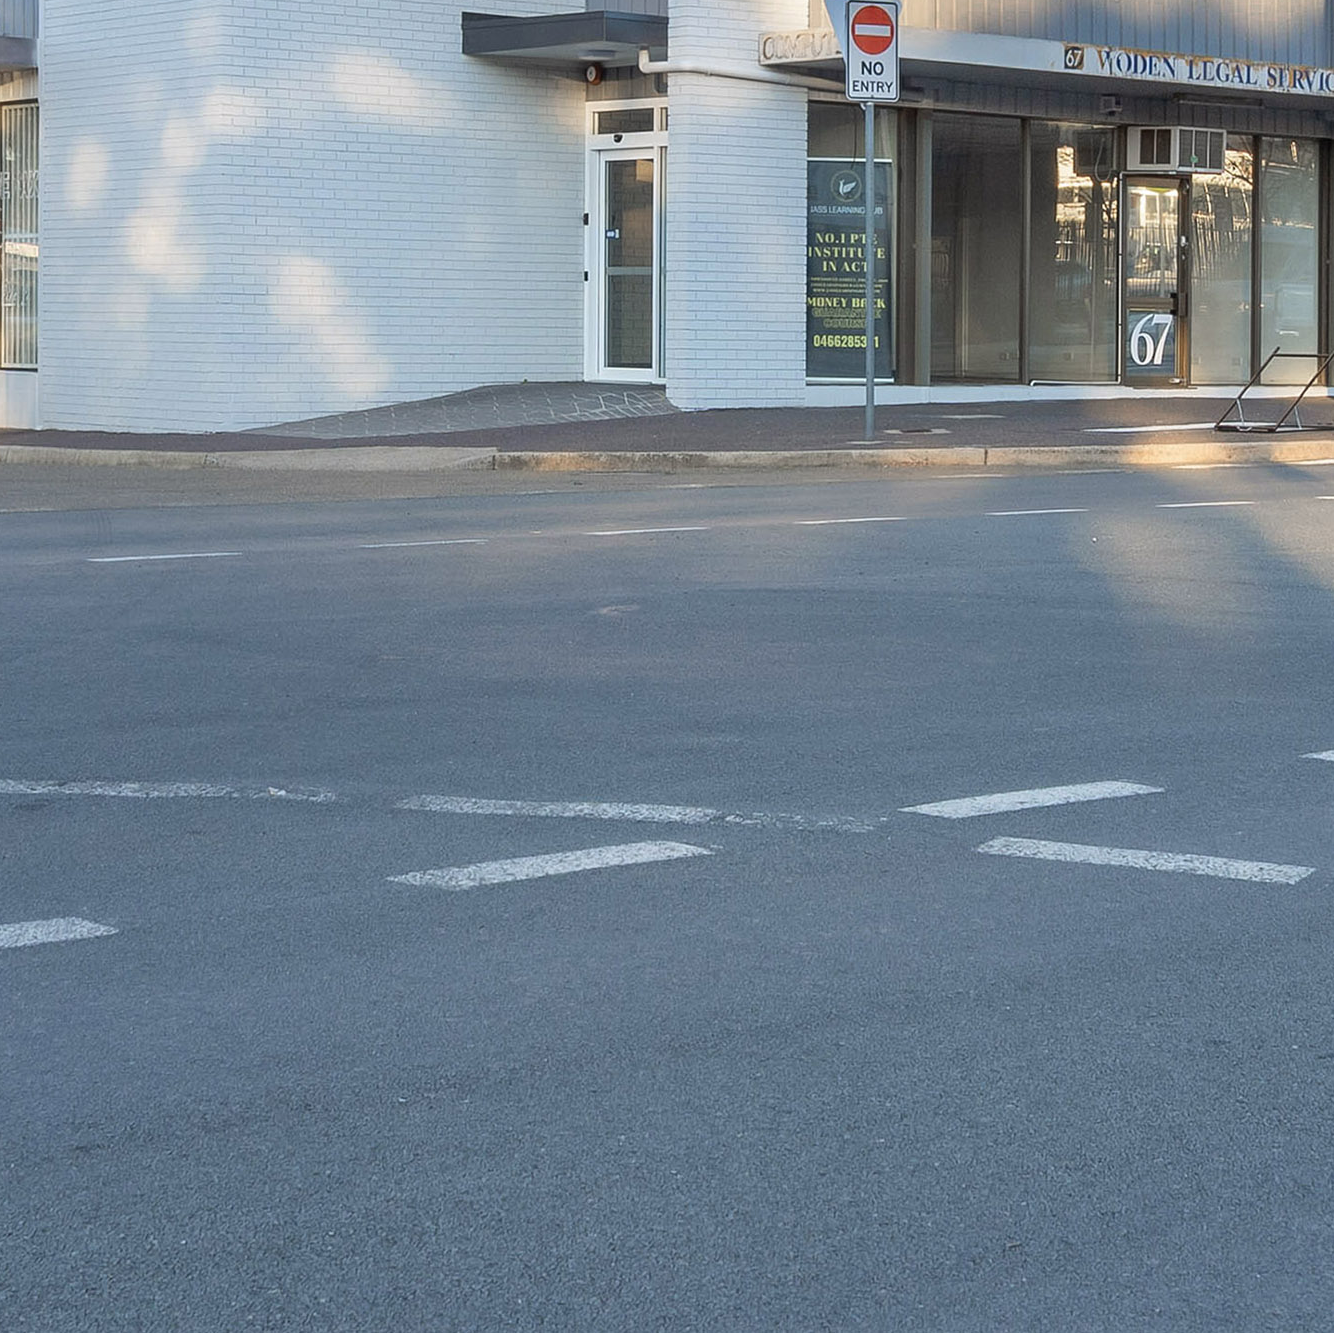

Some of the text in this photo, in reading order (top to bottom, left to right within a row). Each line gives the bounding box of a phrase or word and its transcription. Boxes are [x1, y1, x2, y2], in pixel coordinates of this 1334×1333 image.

[861, 61, 884, 76] NO
[1067, 49, 1082, 66] 67
[1187, 59, 1258, 86] LEGAL
[852, 80, 894, 93] ENTRY
[828, 205, 866, 215] LEARNING
[808, 246, 885, 259] INSTITUE
[822, 260, 867, 272] IN ACT
[807, 297, 847, 308] MONEY
[813, 334, 879, 348] 046628531
[1130, 313, 1173, 366] 67
